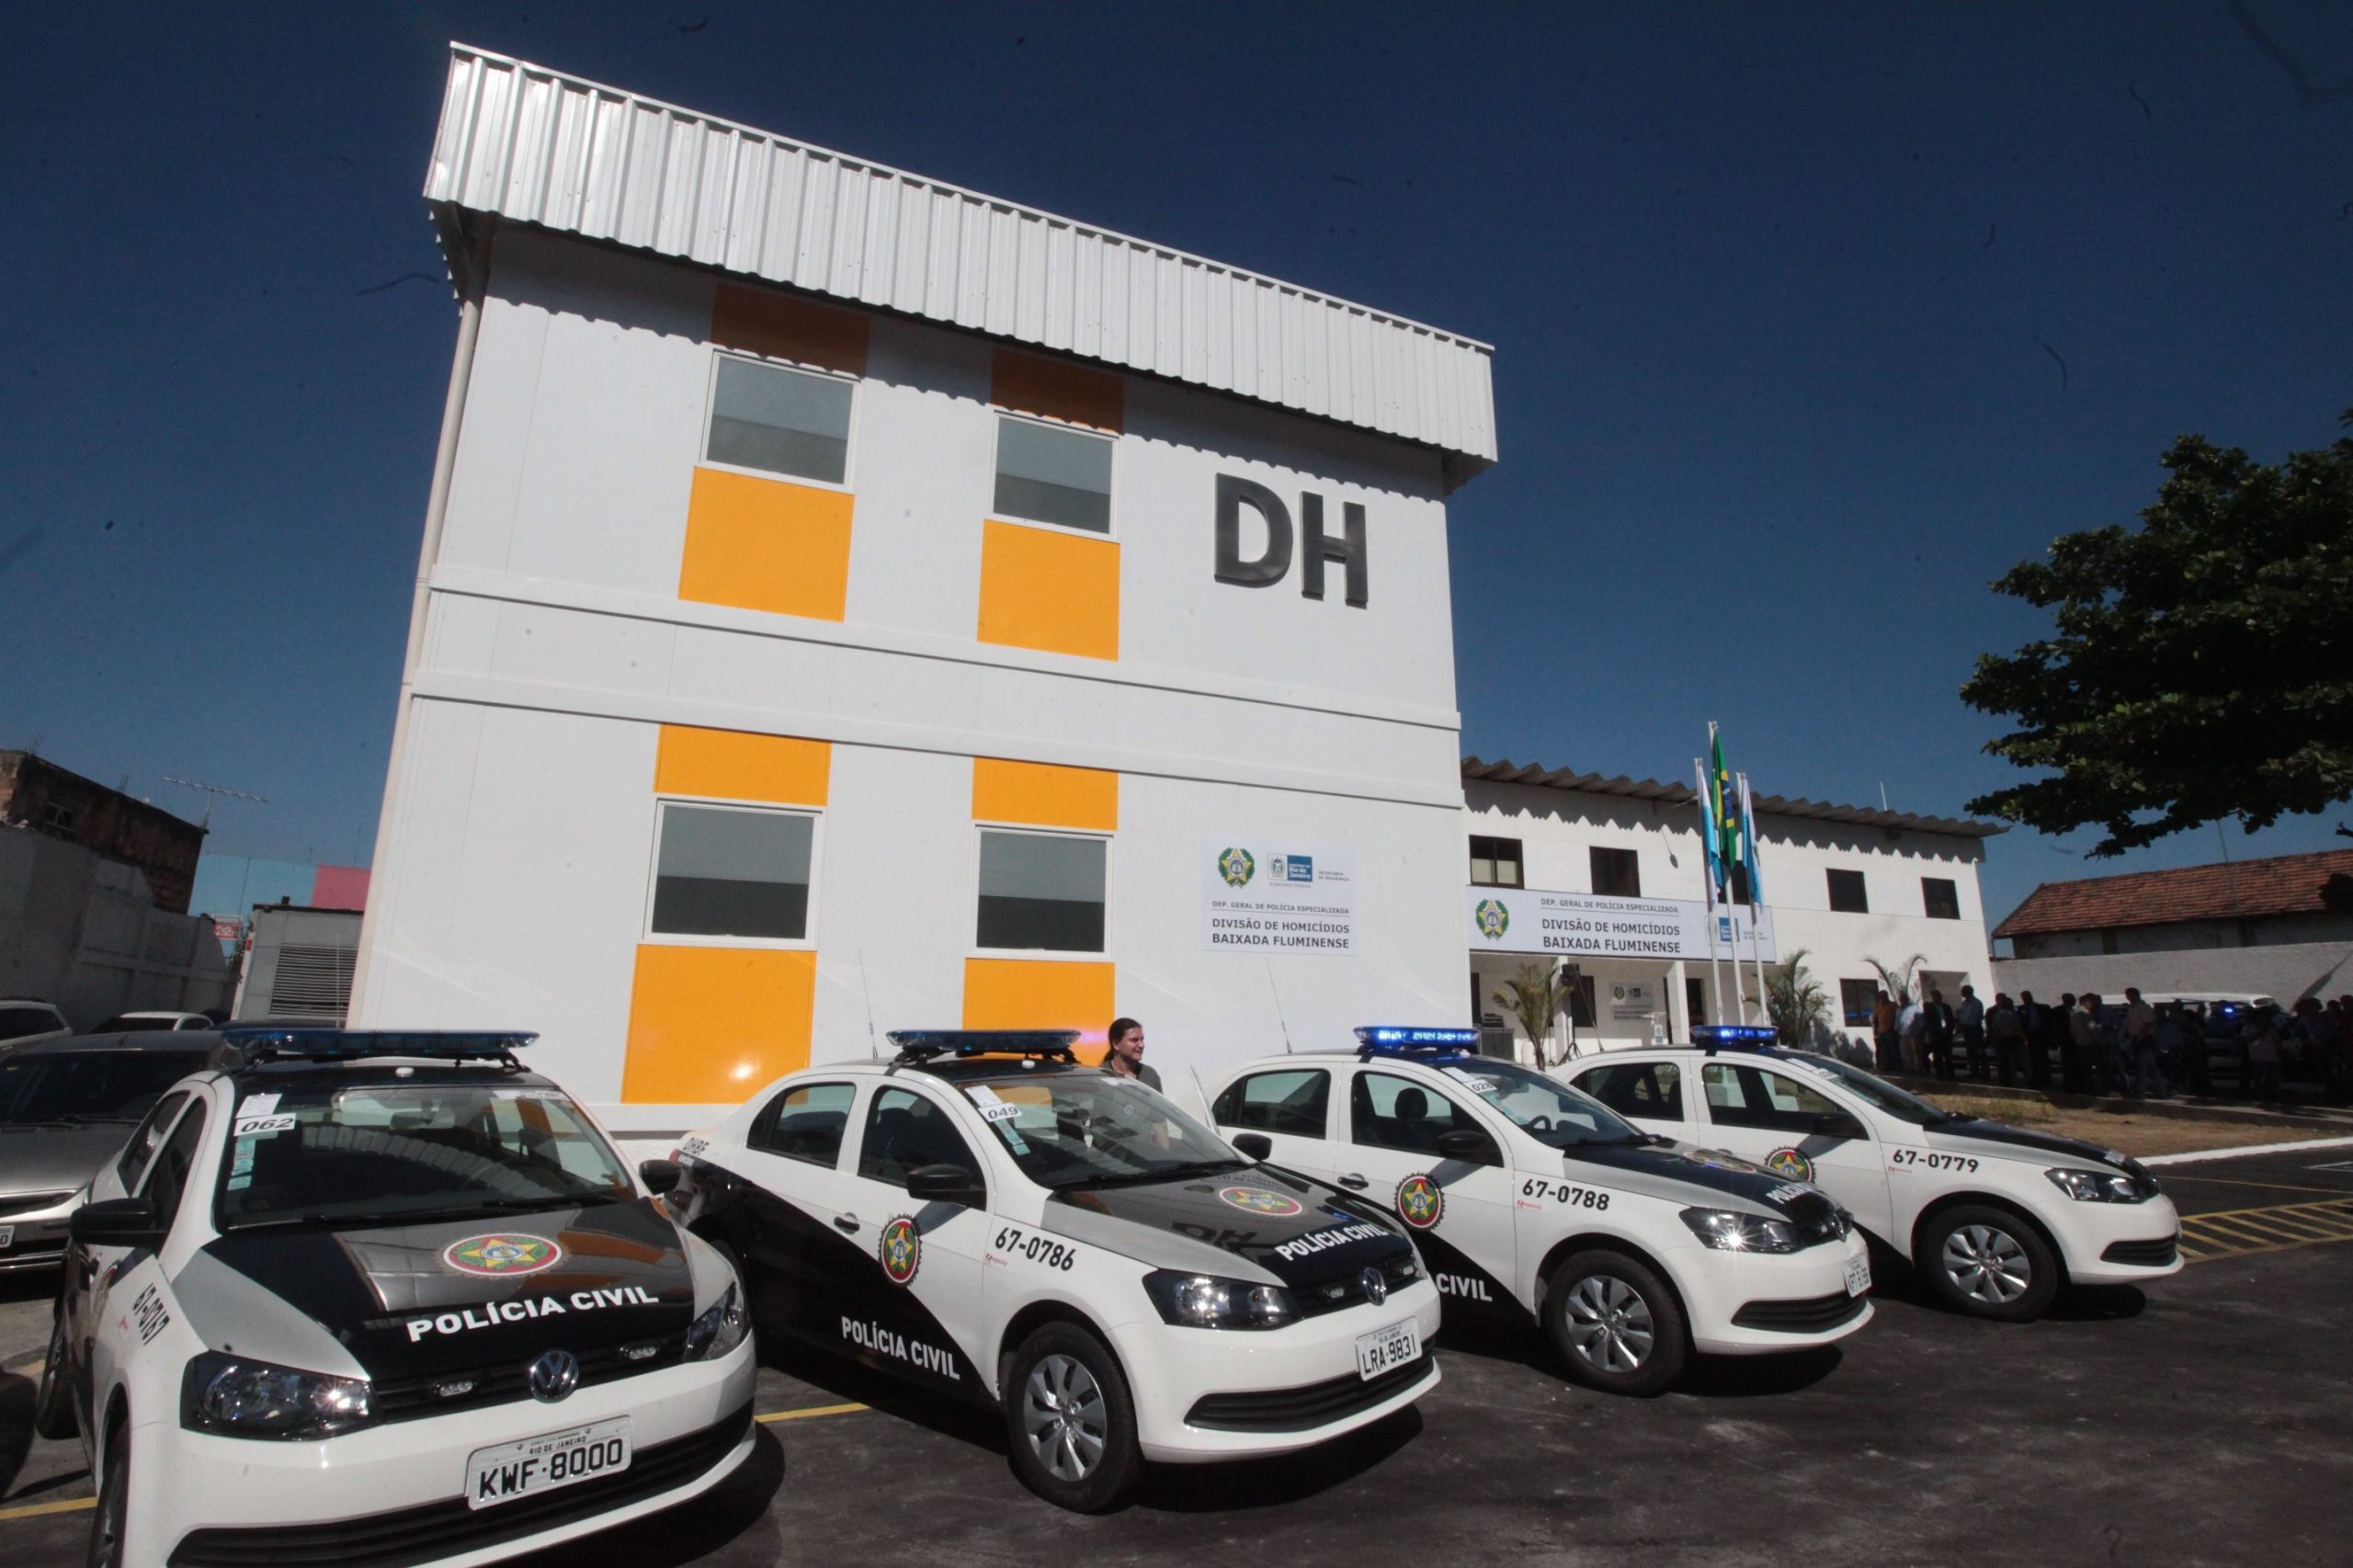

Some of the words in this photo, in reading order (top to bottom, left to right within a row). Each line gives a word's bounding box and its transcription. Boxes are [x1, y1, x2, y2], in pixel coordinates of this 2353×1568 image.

[1214, 472, 1369, 610] DH
[1231, 902, 1254, 910] GERAL
[1267, 903, 1295, 912] POLÍCIA
[1297, 905, 1349, 915] ESPECIALIZADA
[1541, 898, 1557, 906] DEP.
[1560, 900, 1582, 908] GERAL
[1596, 901, 1624, 910] POLÍCIA
[1626, 904, 1678, 913] ESPECIALIZADA
[1212, 918, 1261, 930] DIVISÃO
[1265, 921, 1279, 931] DE
[1282, 921, 1350, 934] HOMICÍDIOS
[1542, 918, 1591, 931] DIVISÃO
[1595, 922, 1608, 932] DE
[1612, 922, 1680, 936] HOMICÍDIOS
[1212, 934, 1269, 946] BAIXADA
[1273, 936, 1349, 949] FLUMINENSE
[1543, 936, 1600, 950] BAIXADA
[1605, 939, 1680, 953] FLUMINENSE
[988, 1107, 1018, 1119] 049
[241, 1118, 294, 1132] 062
[682, 1137, 710, 1156] DHBF
[1893, 1149, 1979, 1173] 67-0779
[1522, 1178, 1609, 1210] 67-0788
[995, 1227, 1076, 1271] 67-0786
[1274, 1230, 1353, 1261] POLÍCIA
[1343, 1223, 1389, 1240] CIVIL
[1436, 1272, 1493, 1302] CIVIL
[406, 1297, 566, 1342] POLÍCIA
[570, 1286, 659, 1311] CIVIL
[841, 1316, 908, 1361] POLÍCIA
[911, 1340, 961, 1381] CIVIL
[529, 1446, 541, 1455] RIO
[544, 1444, 552, 1452] DE
[555, 1436, 586, 1449] JANEIRO
